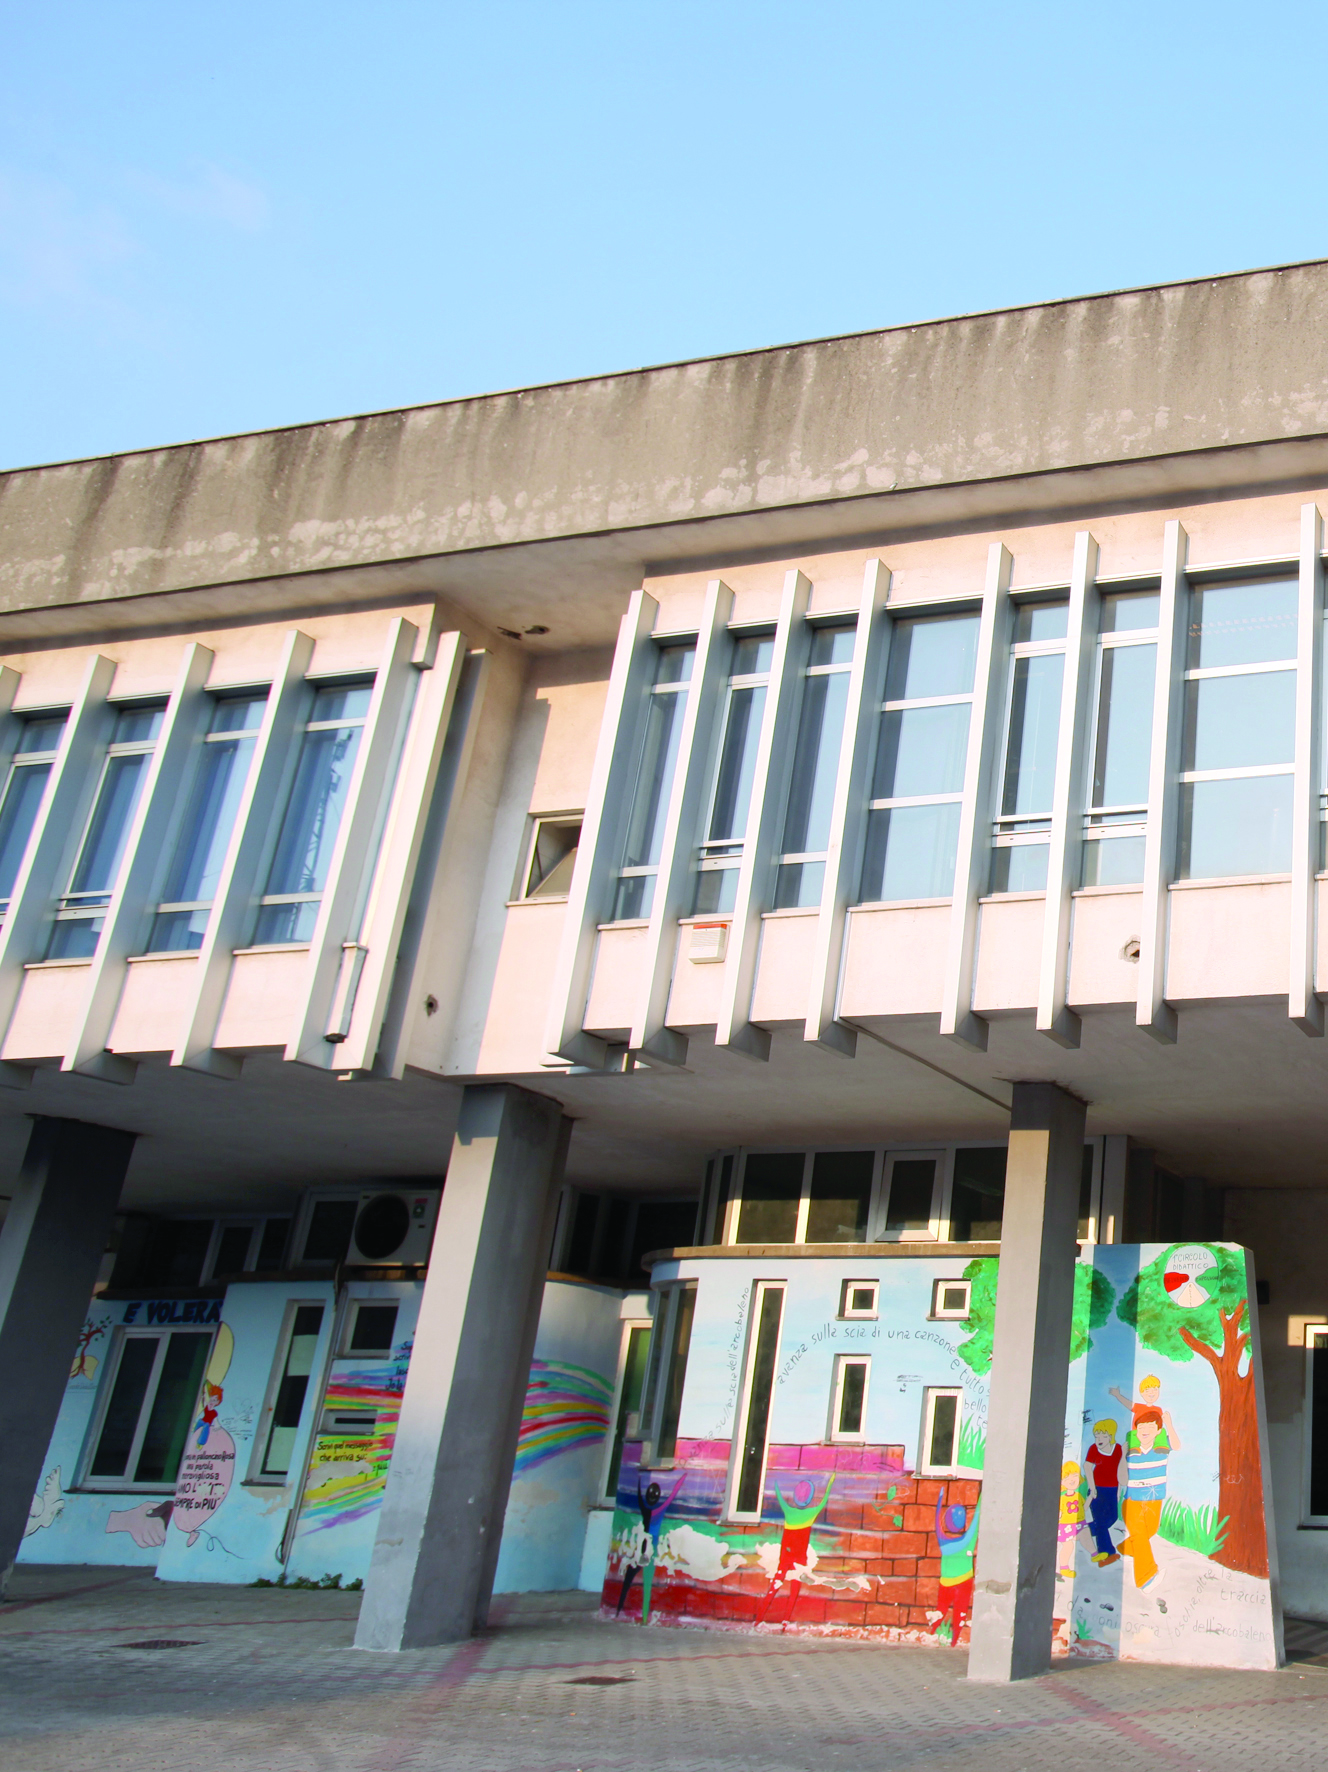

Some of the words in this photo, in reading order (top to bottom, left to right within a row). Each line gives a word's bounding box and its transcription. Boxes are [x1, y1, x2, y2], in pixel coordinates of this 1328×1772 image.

[123, 1302, 142, 1323] E
[777, 1343, 809, 1385] avanza
[811, 1323, 837, 1344] sulla
[843, 1325, 867, 1338] scia
[871, 1326, 881, 1338] di
[888, 1330, 911, 1340] una
[914, 1330, 957, 1355] canzone
[950, 1358, 961, 1371] e
[959, 1368, 985, 1395] tutto
[964, 1398, 987, 1413] bello
[1220, 1588, 1267, 1605] traccia
